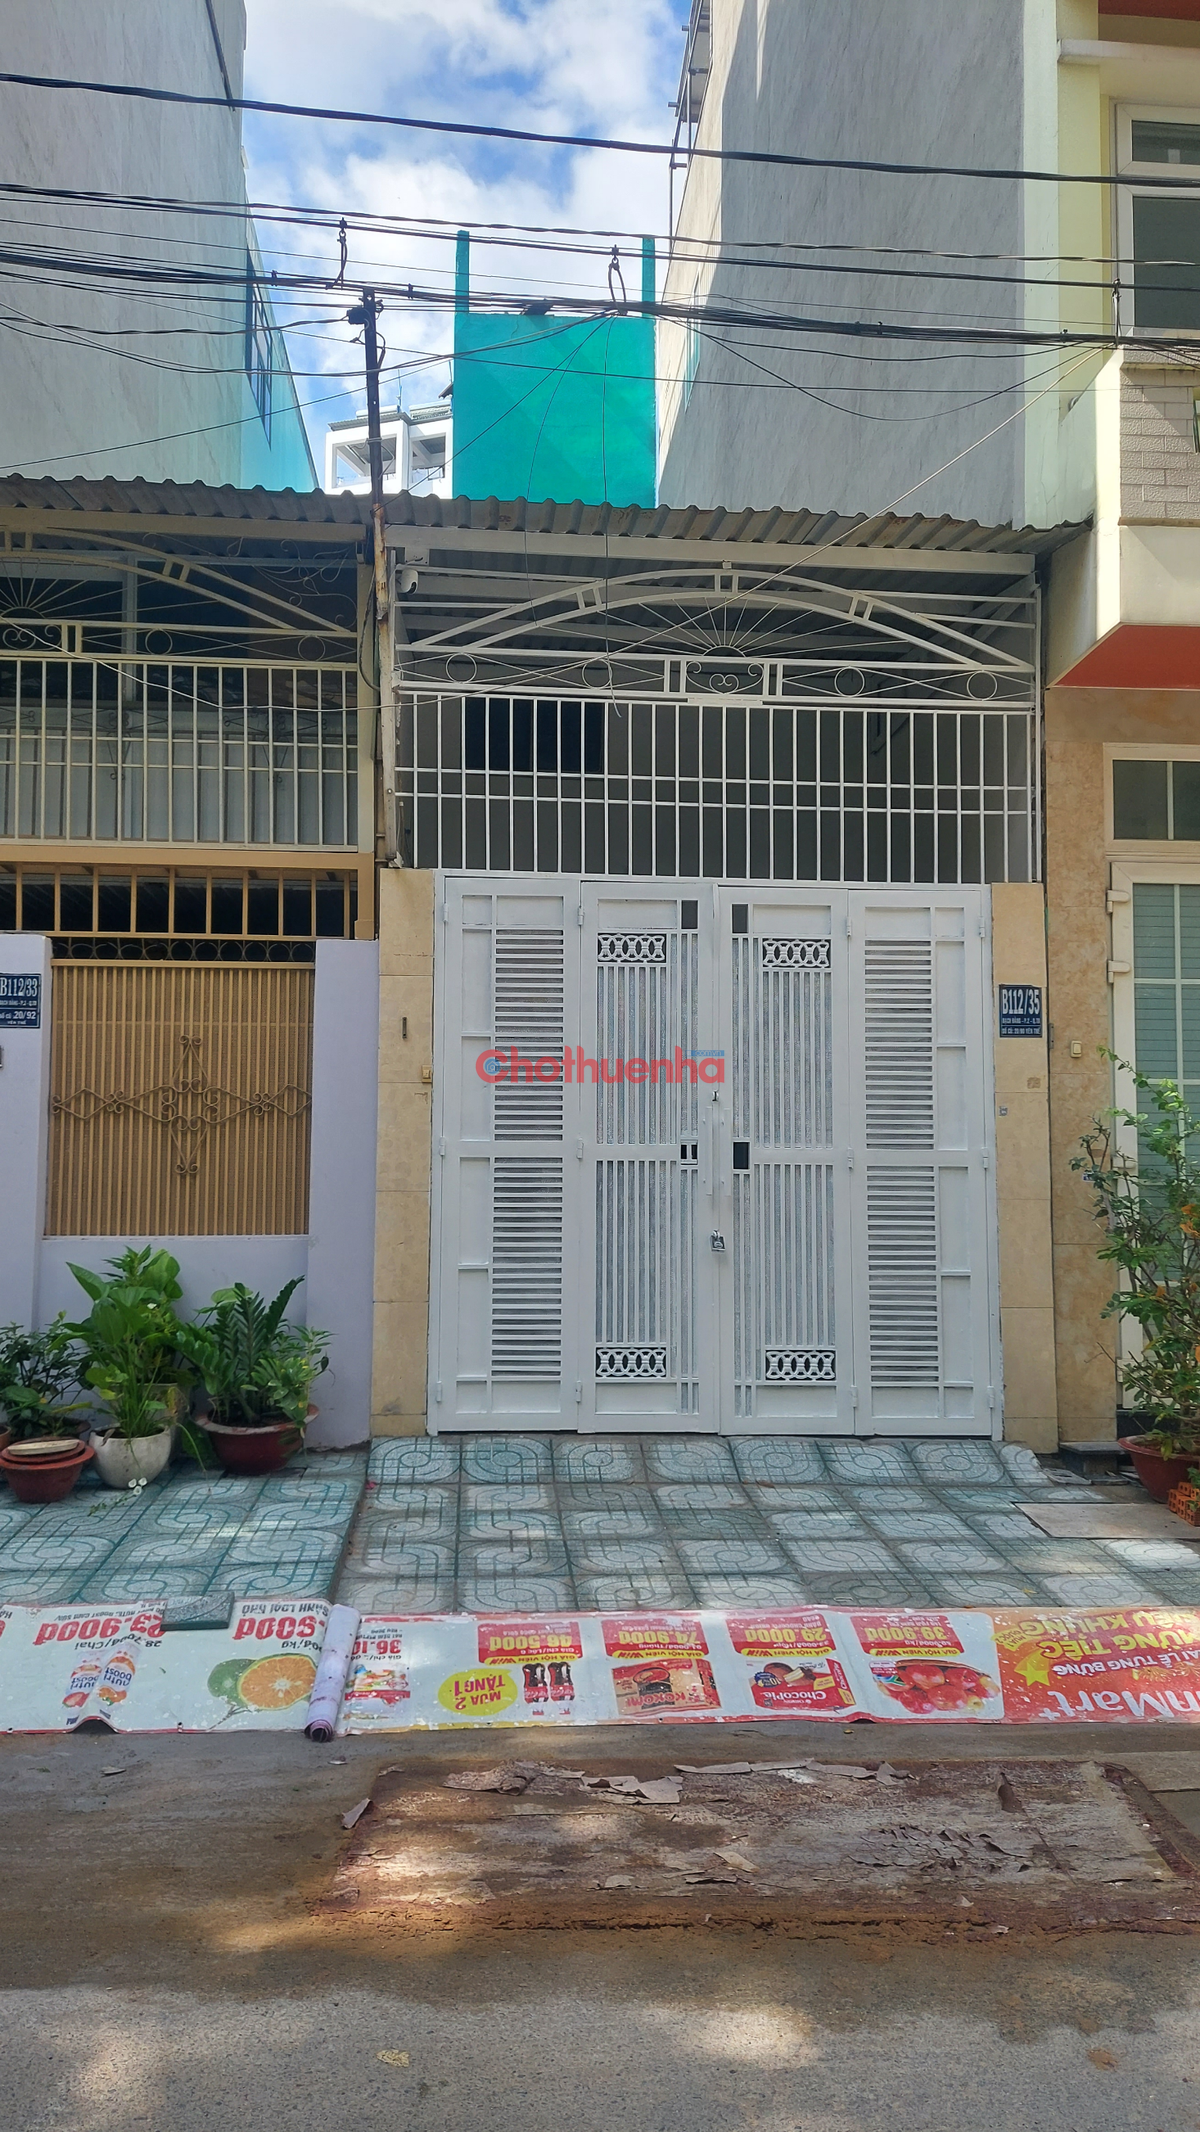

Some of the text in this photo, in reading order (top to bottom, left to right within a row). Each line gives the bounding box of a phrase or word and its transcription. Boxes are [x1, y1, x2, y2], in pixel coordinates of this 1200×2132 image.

[0, 977, 38, 997] B112/33
[1002, 989, 1040, 1014] B112/35
[33, 1613, 165, 1646] 23.900đ
[744, 1627, 826, 1642] 29.000đ
[864, 1626, 947, 1641] 39.900đ
[489, 1634, 572, 1651] 46.500đ
[619, 1631, 700, 1644] 74.900đ
[352, 1640, 401, 1655] 36.10
[105, 1667, 132, 1681] boost
[1052, 1661, 1106, 1676] BỪNG
[103, 1673, 130, 1686] nutri
[454, 1674, 505, 1697] TẶNG 1
[454, 1690, 501, 1710] MUA 2
[627, 1692, 685, 1707] KOKOMI
[763, 1690, 826, 1700] ChocoPie
[1039, 1690, 1200, 1721] nMart+
